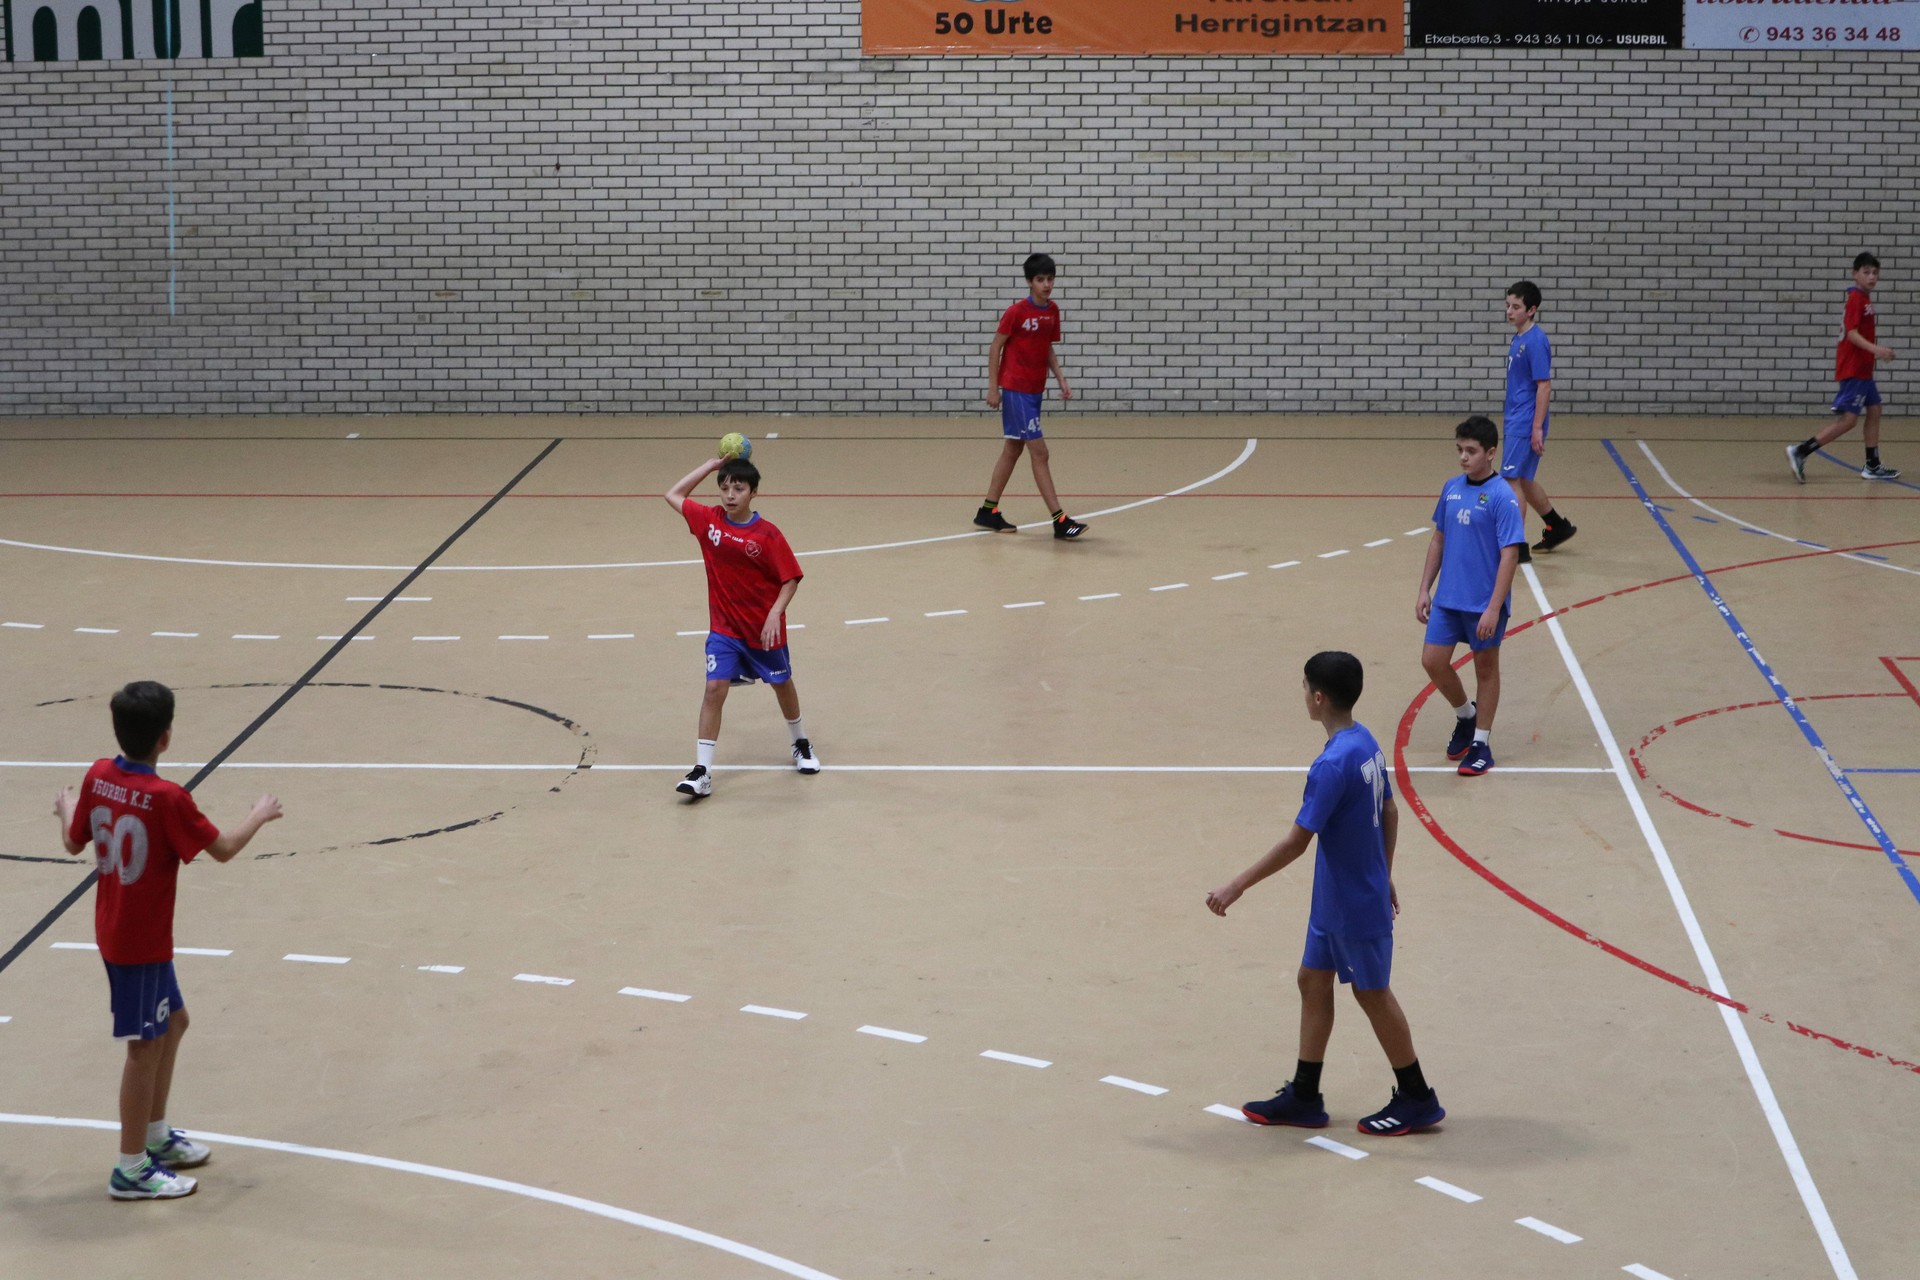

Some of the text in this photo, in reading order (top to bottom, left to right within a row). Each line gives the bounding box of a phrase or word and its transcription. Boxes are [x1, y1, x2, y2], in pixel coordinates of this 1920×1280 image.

[935, 9, 1053, 35] 50 Urte
[1174, 13, 1387, 37] Herrigintzan
[1424, 33, 1502, 45] Etxebeste,3
[1514, 33, 1540, 44] 943
[1544, 34, 1561, 45] 36
[1566, 34, 1580, 44] 11
[1586, 34, 1604, 45] 06
[1616, 34, 1668, 45] USURBIL
[1766, 26, 1901, 42] 943 36 34 48
[1021, 317, 1039, 331] 45
[1456, 507, 1472, 525] 46
[707, 523, 722, 547] 28
[130, 789, 153, 811] K.E.
[90, 804, 149, 886] 60
[155, 996, 170, 1024] 6
